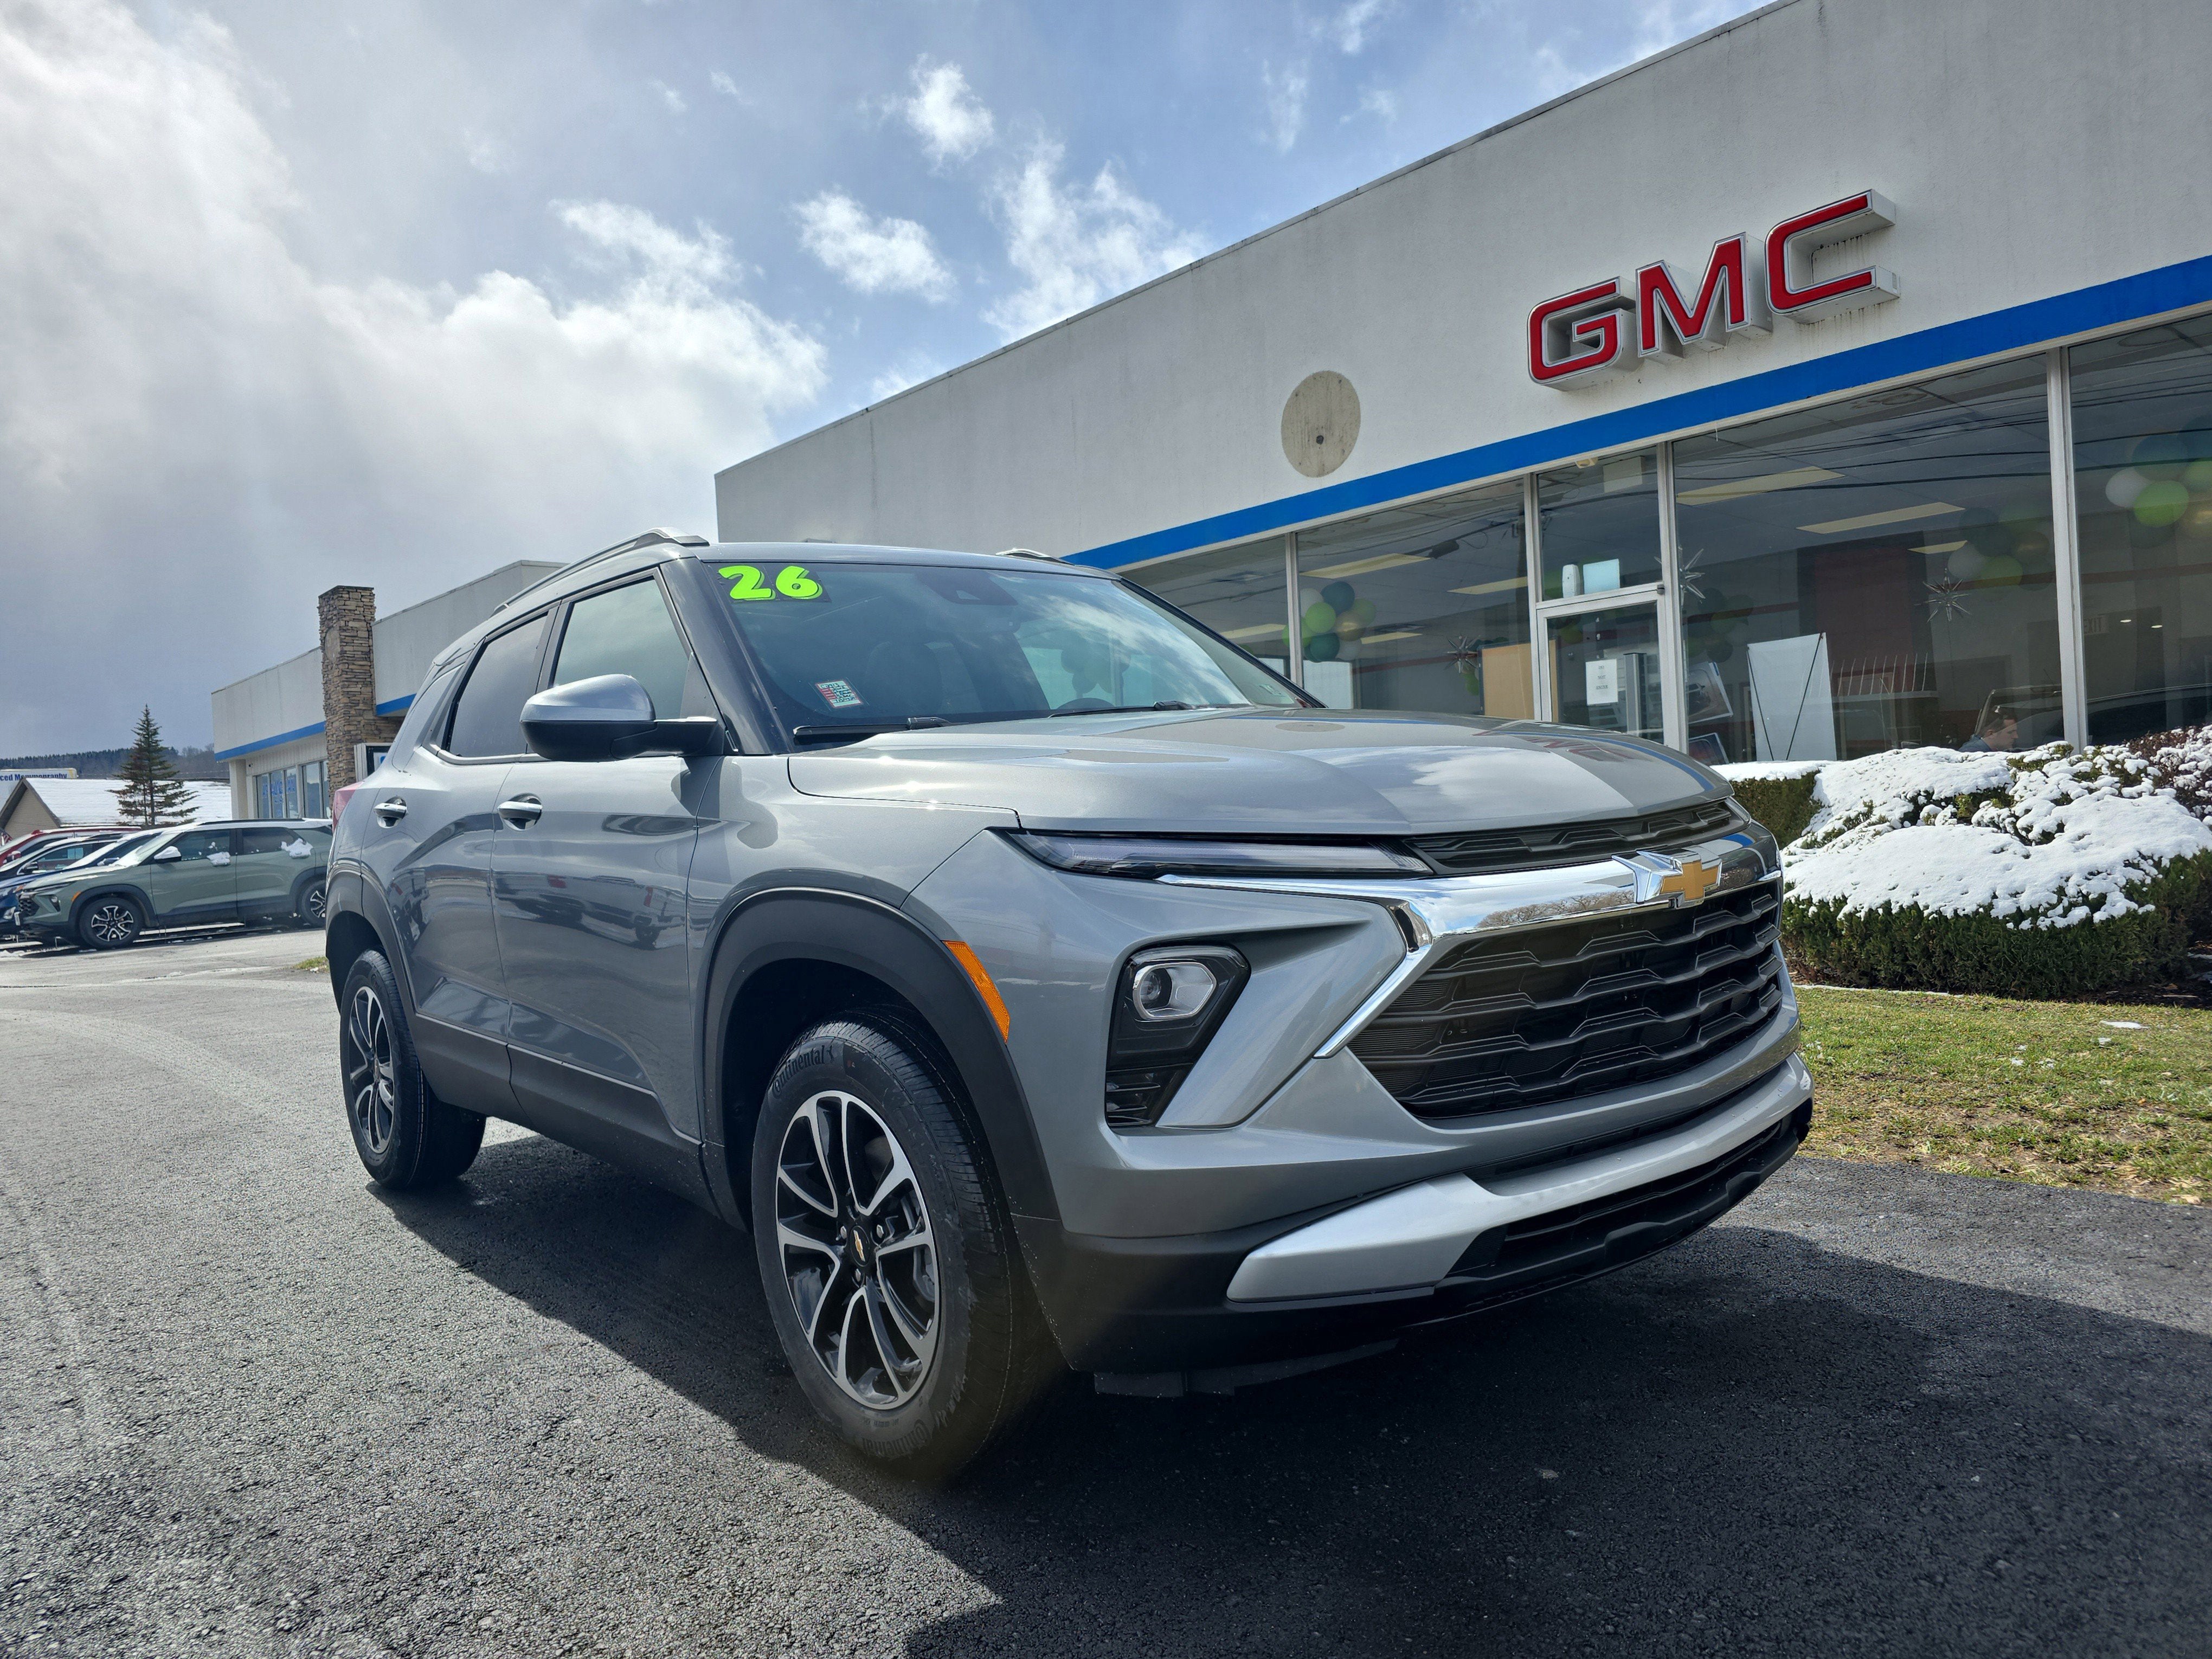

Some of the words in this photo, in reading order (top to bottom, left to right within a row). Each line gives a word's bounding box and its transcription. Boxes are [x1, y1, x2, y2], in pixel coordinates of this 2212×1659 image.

[1527, 189, 1878, 386] GMC
[718, 565, 822, 601] 26
[772, 1045, 825, 1099] Continental
